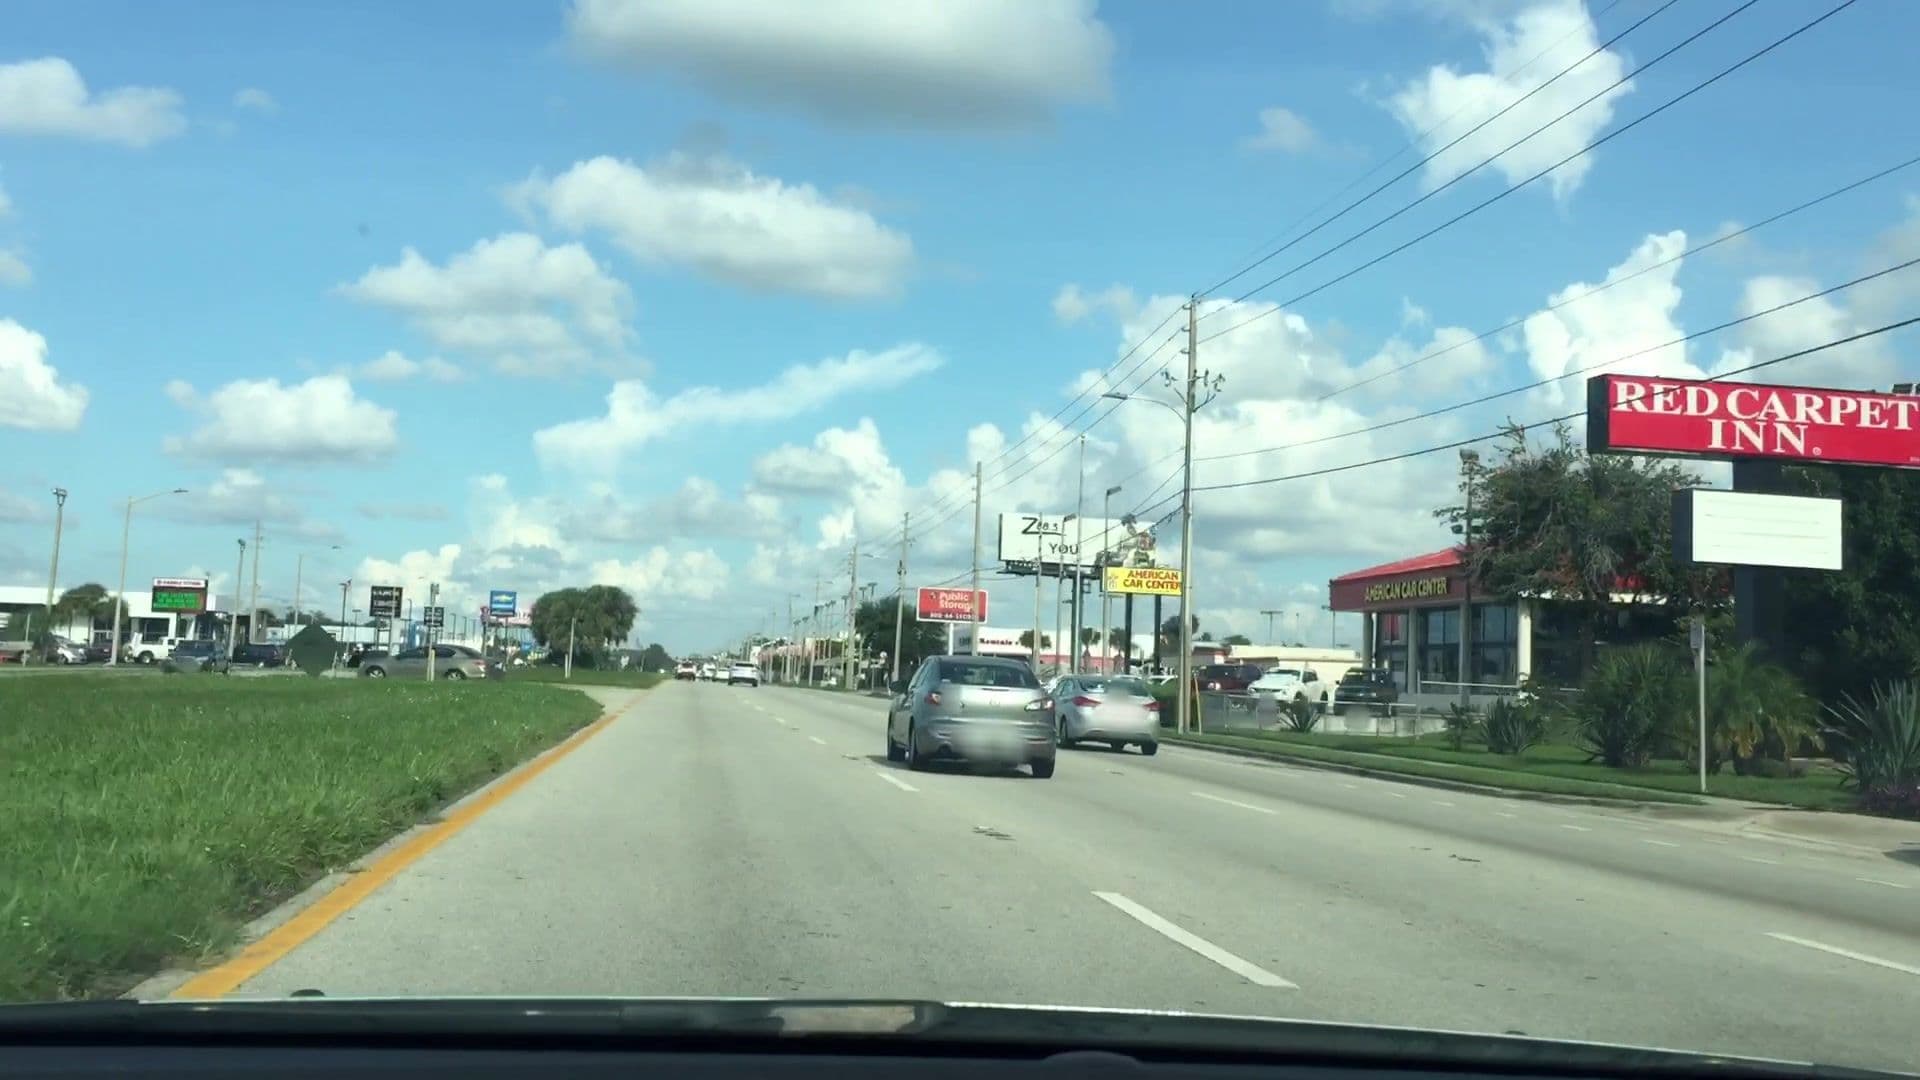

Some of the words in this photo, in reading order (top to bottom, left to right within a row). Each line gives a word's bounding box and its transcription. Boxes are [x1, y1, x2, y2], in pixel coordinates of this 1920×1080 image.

[1611, 380, 1719, 416] RED
[1726, 388, 1919, 431] CARPET
[1707, 418, 1809, 456] INN
[1049, 543, 1079, 556] YOU
[1127, 570, 1179, 581] AMERICAN
[1123, 579, 1143, 588] CAR
[1365, 582, 1401, 602] AMERICAN
[1401, 580, 1417, 599] CAR
[1418, 576, 1447, 597] CENTER
[939, 592, 969, 602] Public
